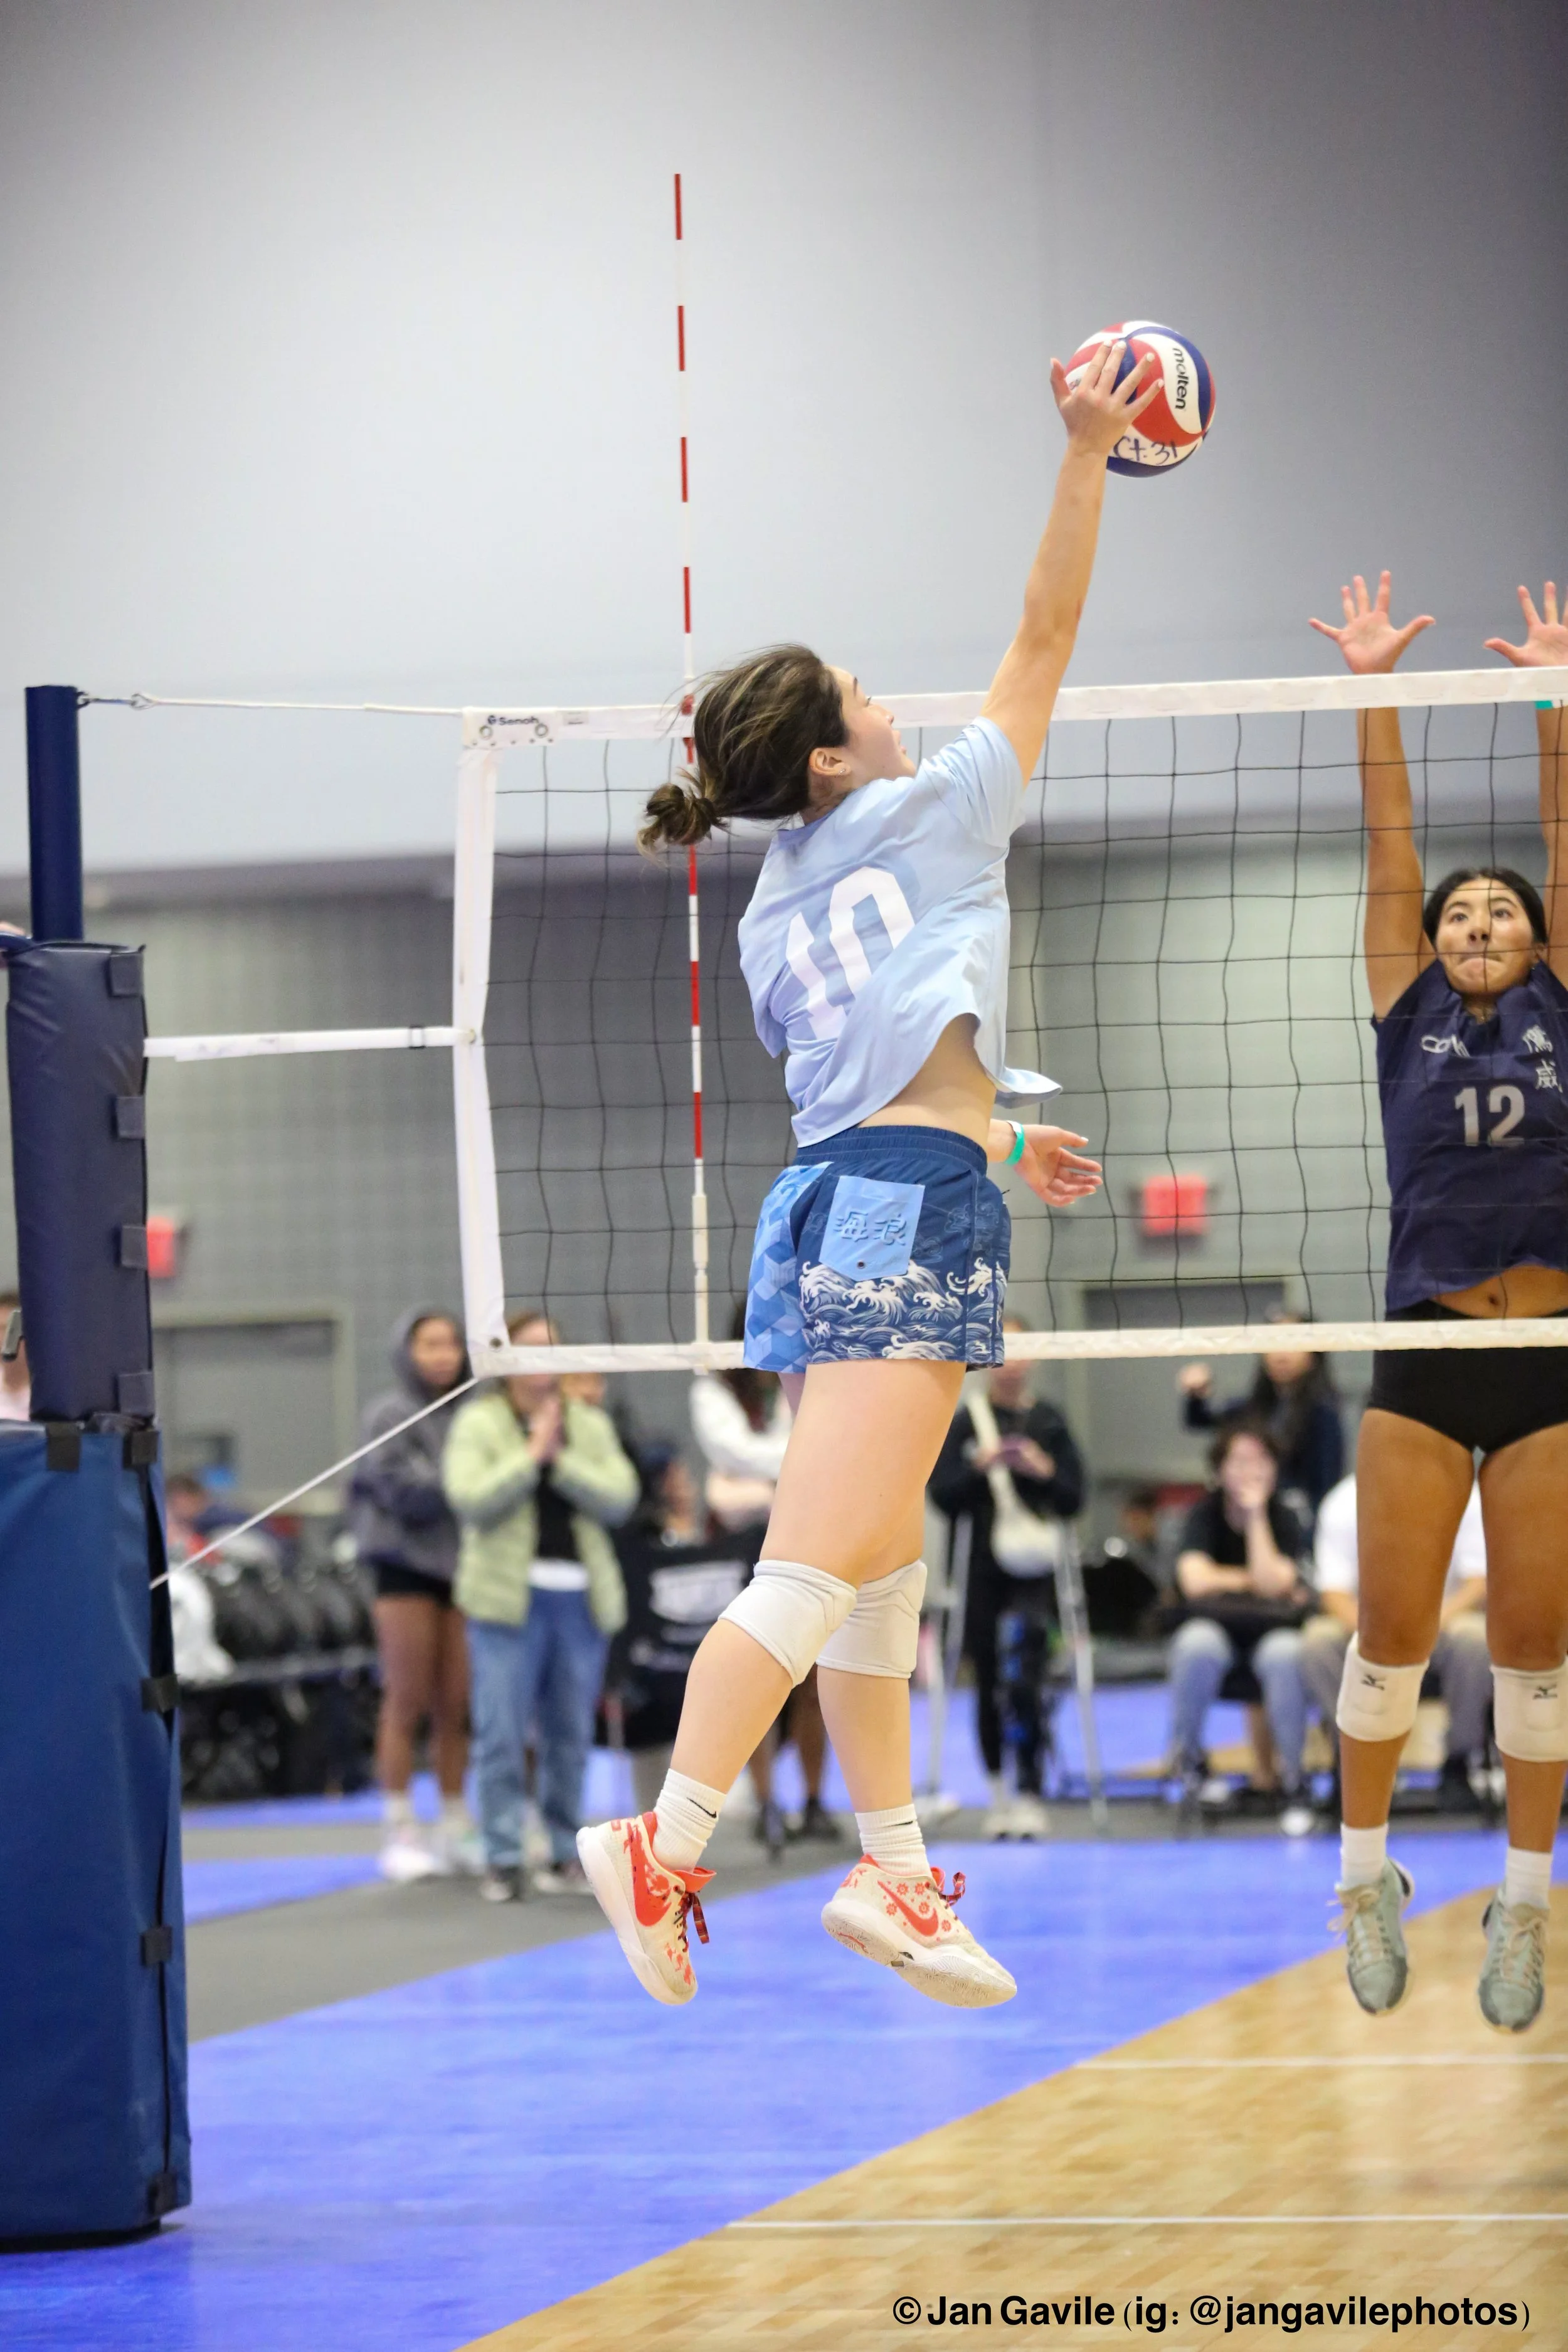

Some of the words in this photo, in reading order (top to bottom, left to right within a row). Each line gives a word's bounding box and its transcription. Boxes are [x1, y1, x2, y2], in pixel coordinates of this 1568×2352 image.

[1172, 347, 1190, 411] molten
[1150, 440, 1179, 465] 31
[1454, 1084, 1525, 1147] 12
